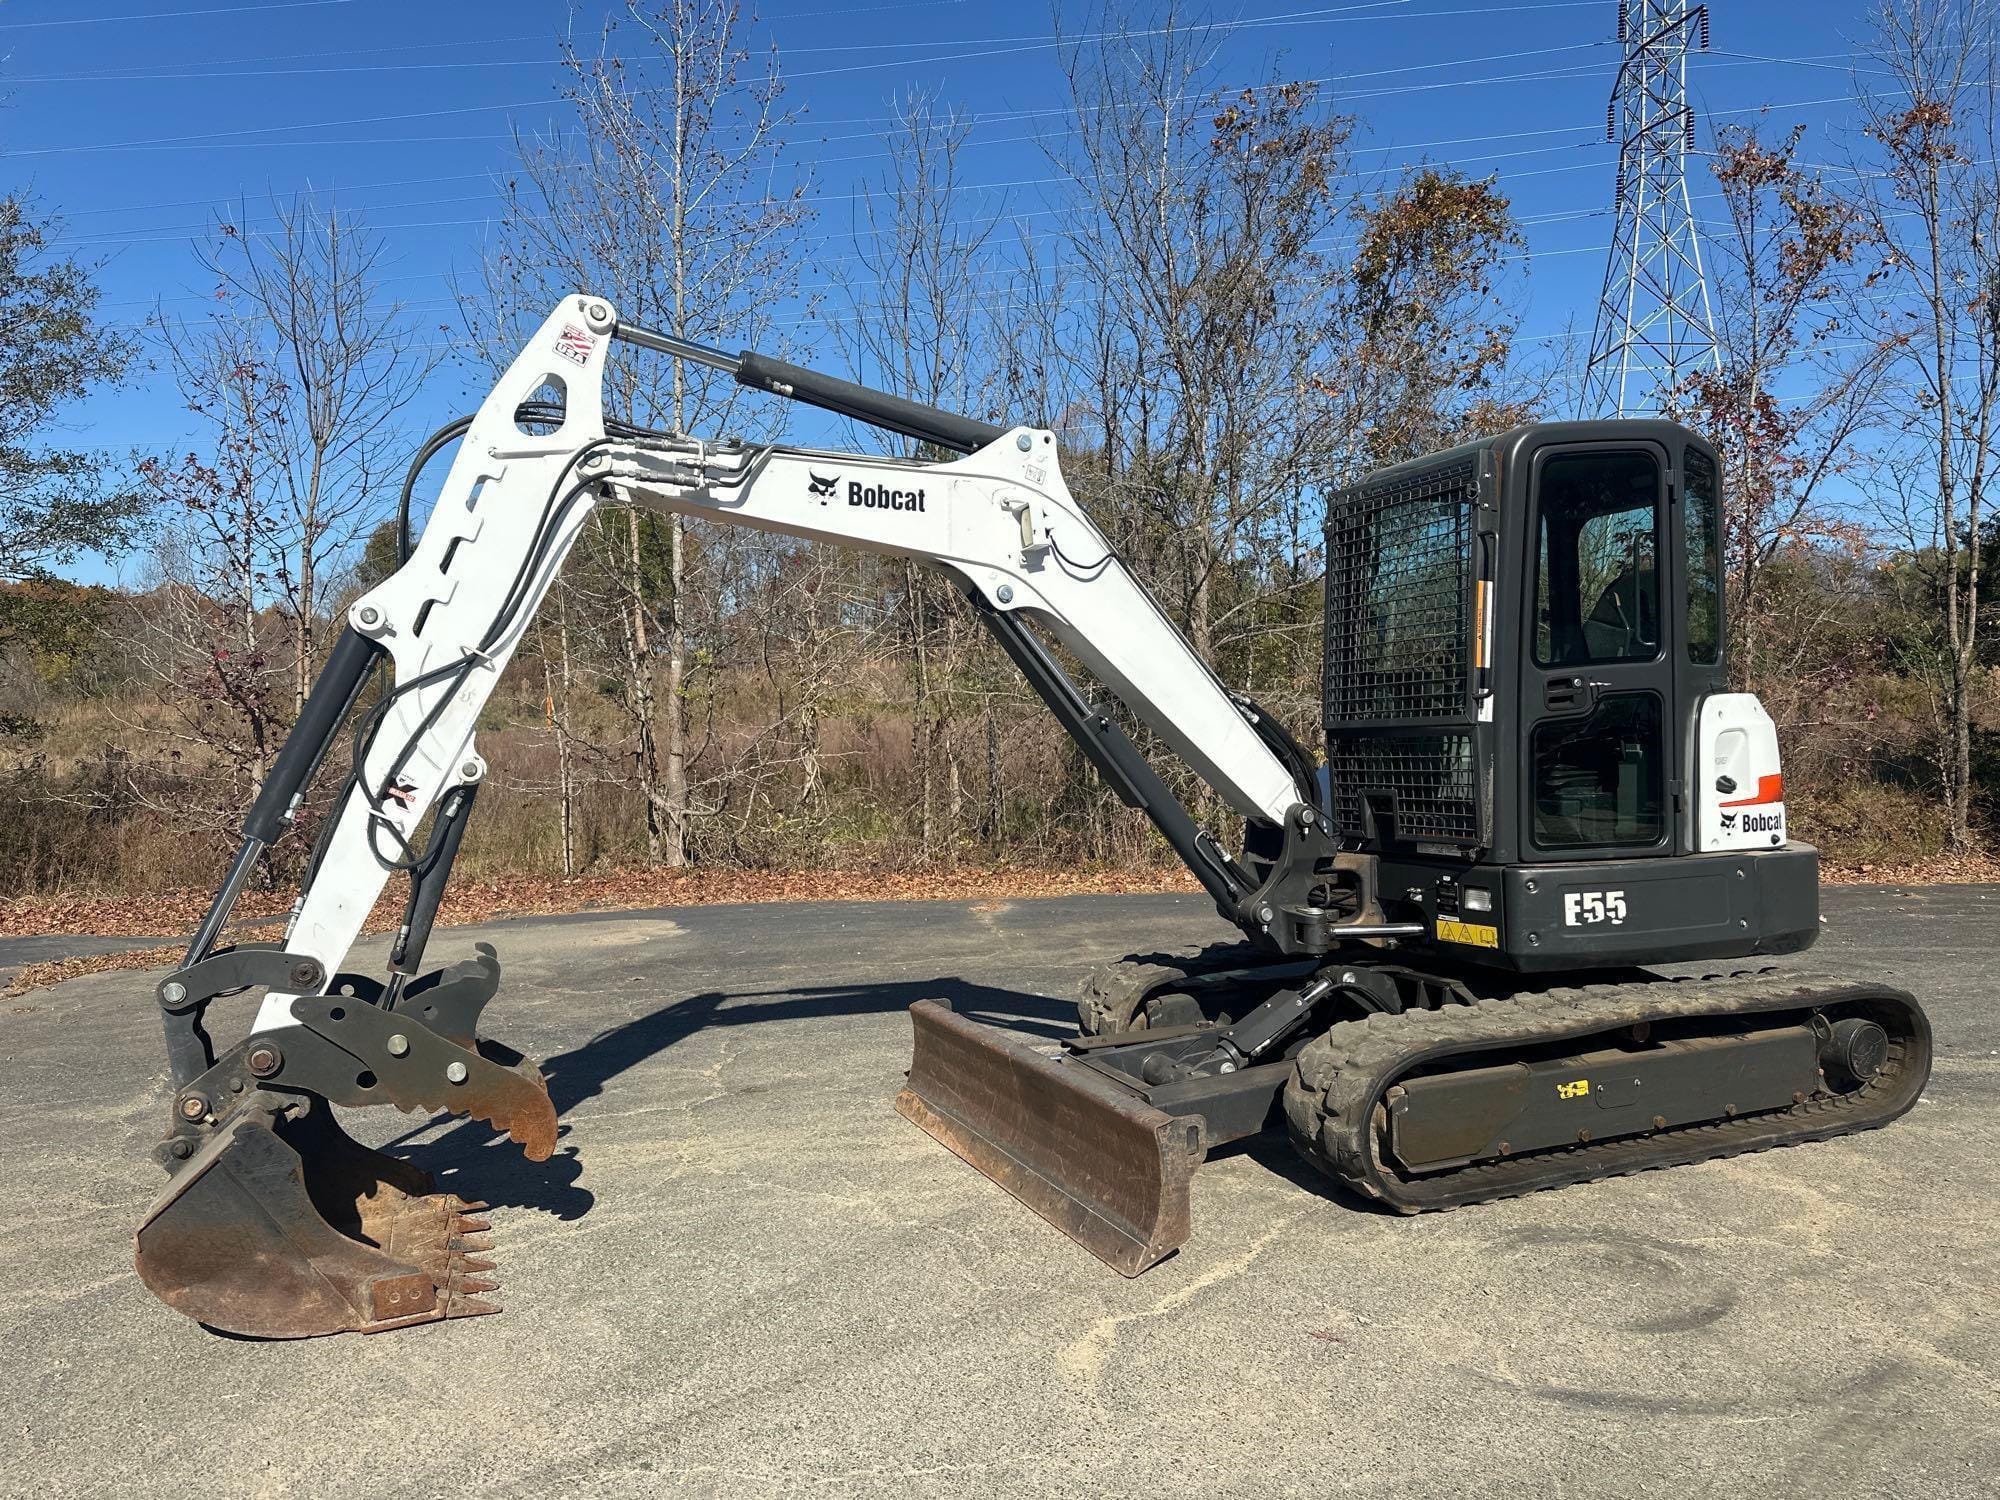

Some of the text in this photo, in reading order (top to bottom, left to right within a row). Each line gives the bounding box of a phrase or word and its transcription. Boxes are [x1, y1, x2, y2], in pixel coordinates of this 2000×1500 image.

[556, 342, 587, 364] USA
[848, 481, 925, 512] Bobcat
[1742, 811, 1782, 833] Bobcat
[1564, 890, 1627, 926] E55
